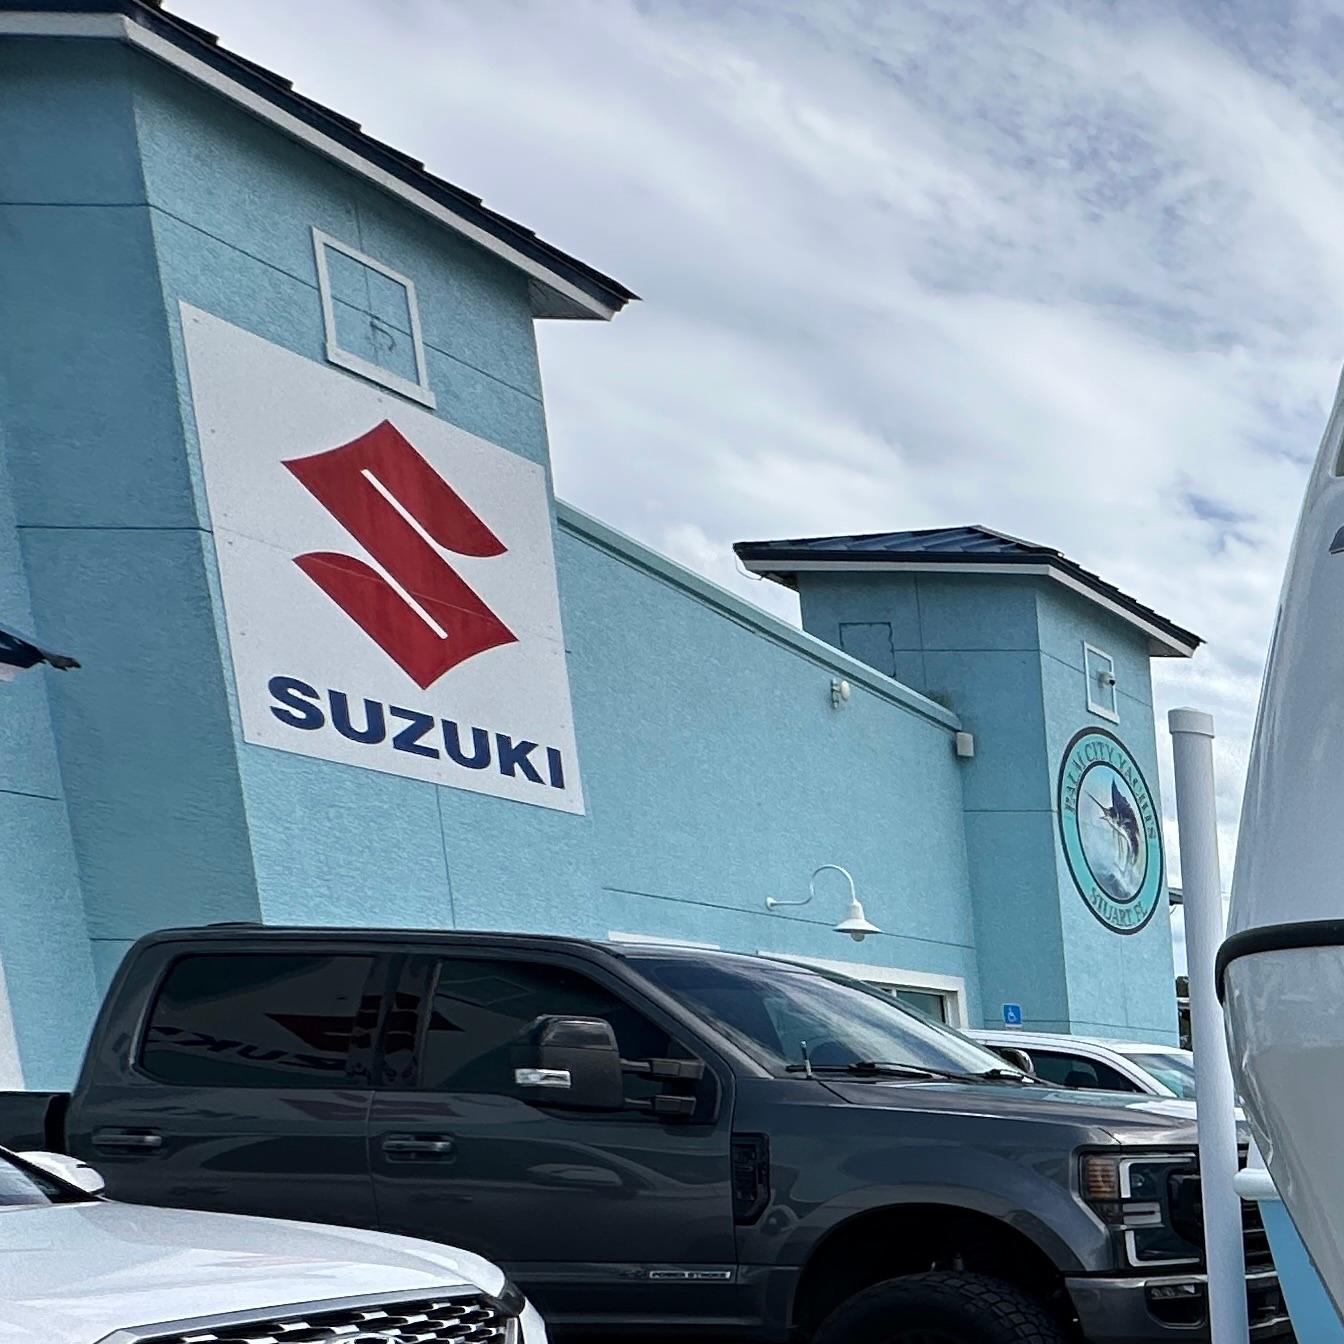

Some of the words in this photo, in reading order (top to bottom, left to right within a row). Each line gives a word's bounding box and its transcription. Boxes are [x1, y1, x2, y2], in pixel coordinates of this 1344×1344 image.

[268, 676, 566, 790] SUZUKI
[1085, 741, 1115, 763] CITY
[1088, 886, 1133, 928] STUART
